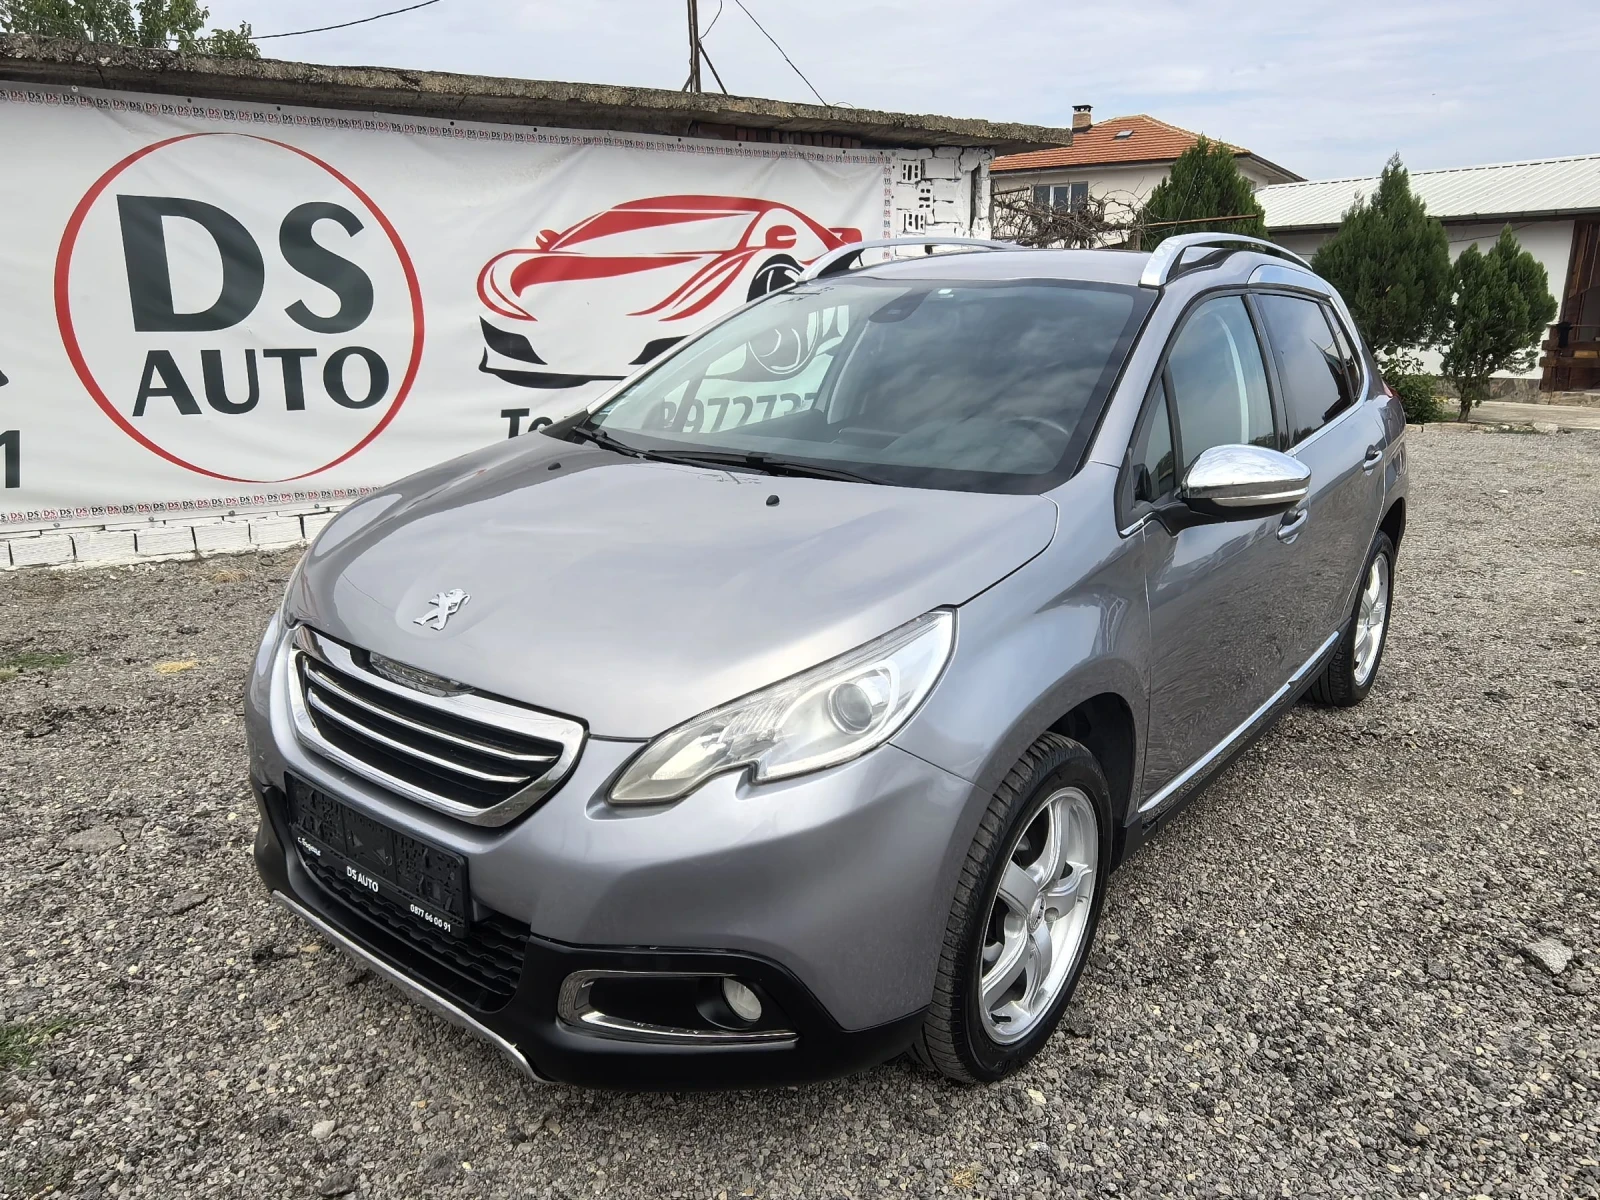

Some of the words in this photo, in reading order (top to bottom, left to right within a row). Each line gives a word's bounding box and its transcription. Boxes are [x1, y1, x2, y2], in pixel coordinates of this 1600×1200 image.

[117, 194, 374, 334] DS
[132, 346, 390, 417] AUTO
[346, 865, 357, 880] DS
[358, 873, 379, 893] AUTO
[410, 904, 425, 918] 0877
[443, 922, 451, 932] 91
